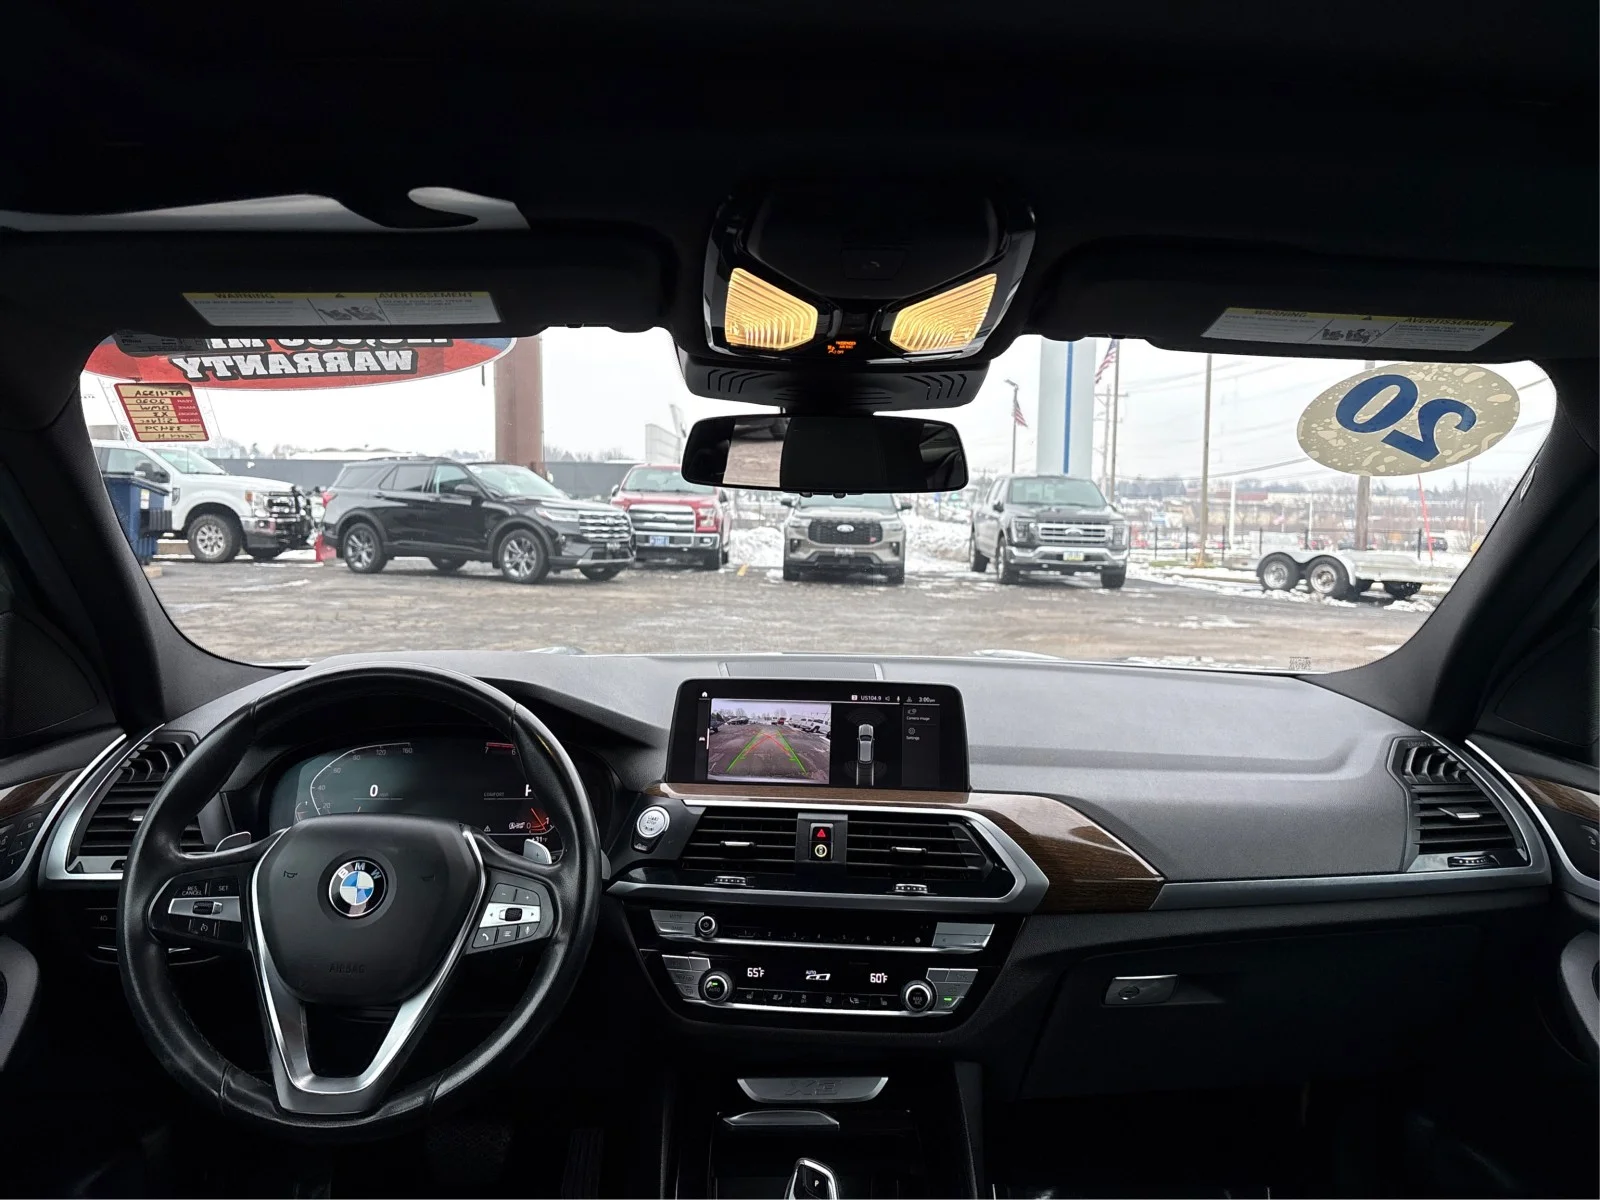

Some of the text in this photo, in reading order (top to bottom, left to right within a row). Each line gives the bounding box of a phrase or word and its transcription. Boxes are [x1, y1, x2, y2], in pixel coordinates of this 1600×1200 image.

[1254, 310, 1308, 318] WARNING
[1404, 317, 1498, 327] AVERTISSEMENT
[369, 784, 379, 798] 0
[338, 862, 382, 880] BMW
